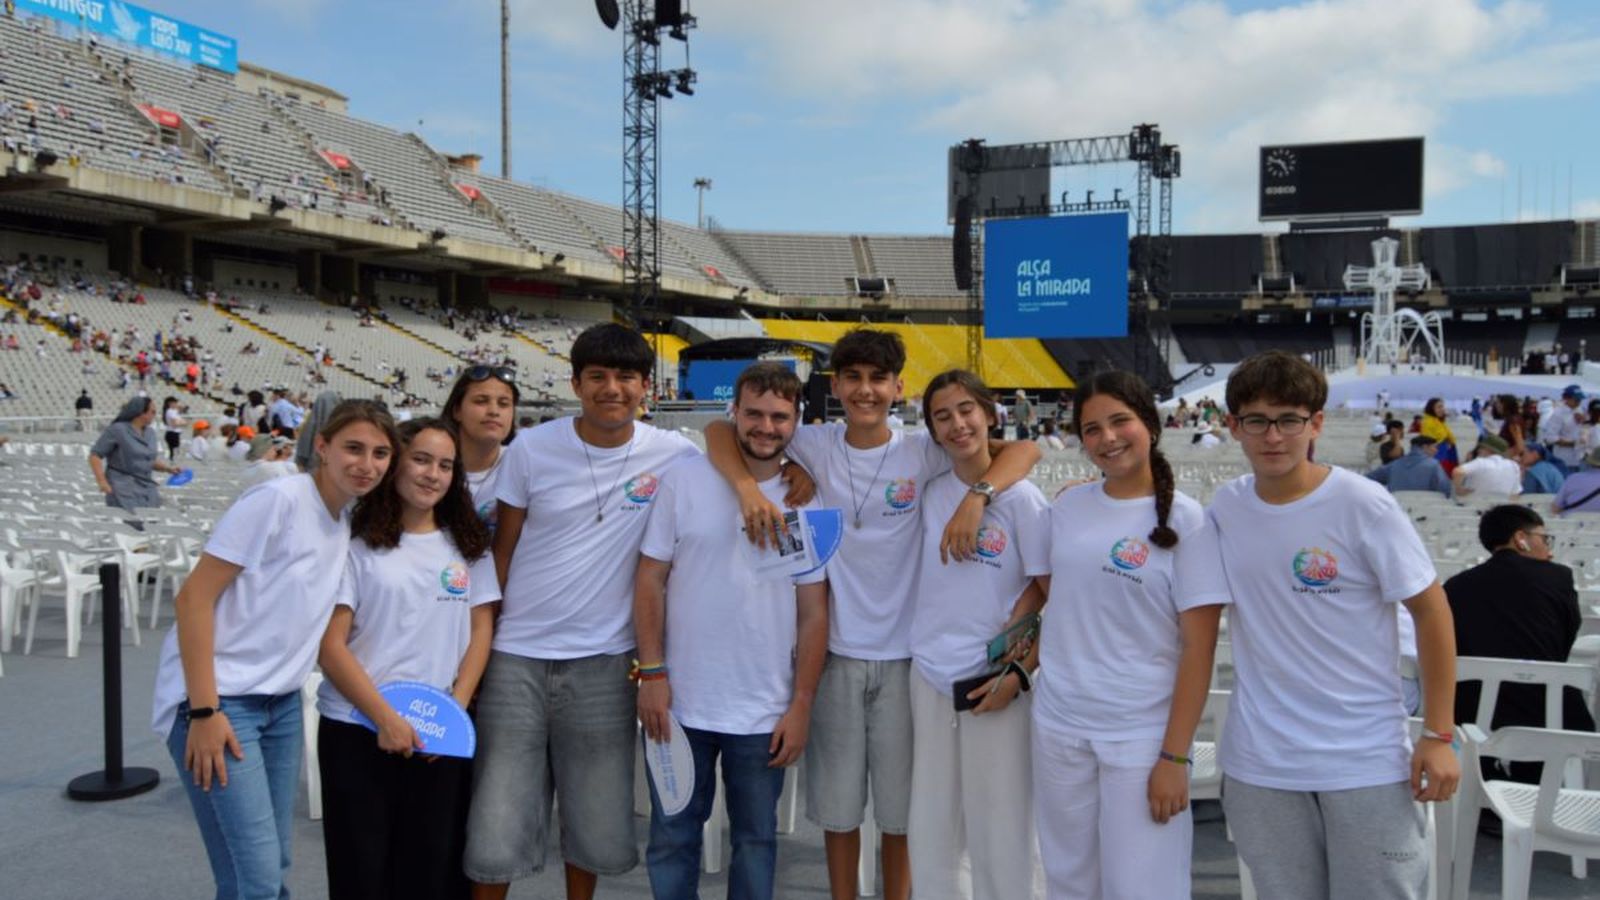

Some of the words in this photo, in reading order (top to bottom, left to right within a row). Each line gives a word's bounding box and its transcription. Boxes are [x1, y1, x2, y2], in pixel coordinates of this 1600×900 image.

[1017, 259, 1050, 280] ALÇA
[1017, 280, 1031, 297] LA
[1035, 278, 1091, 296] MIRADA
[408, 699, 438, 718] ALÇA
